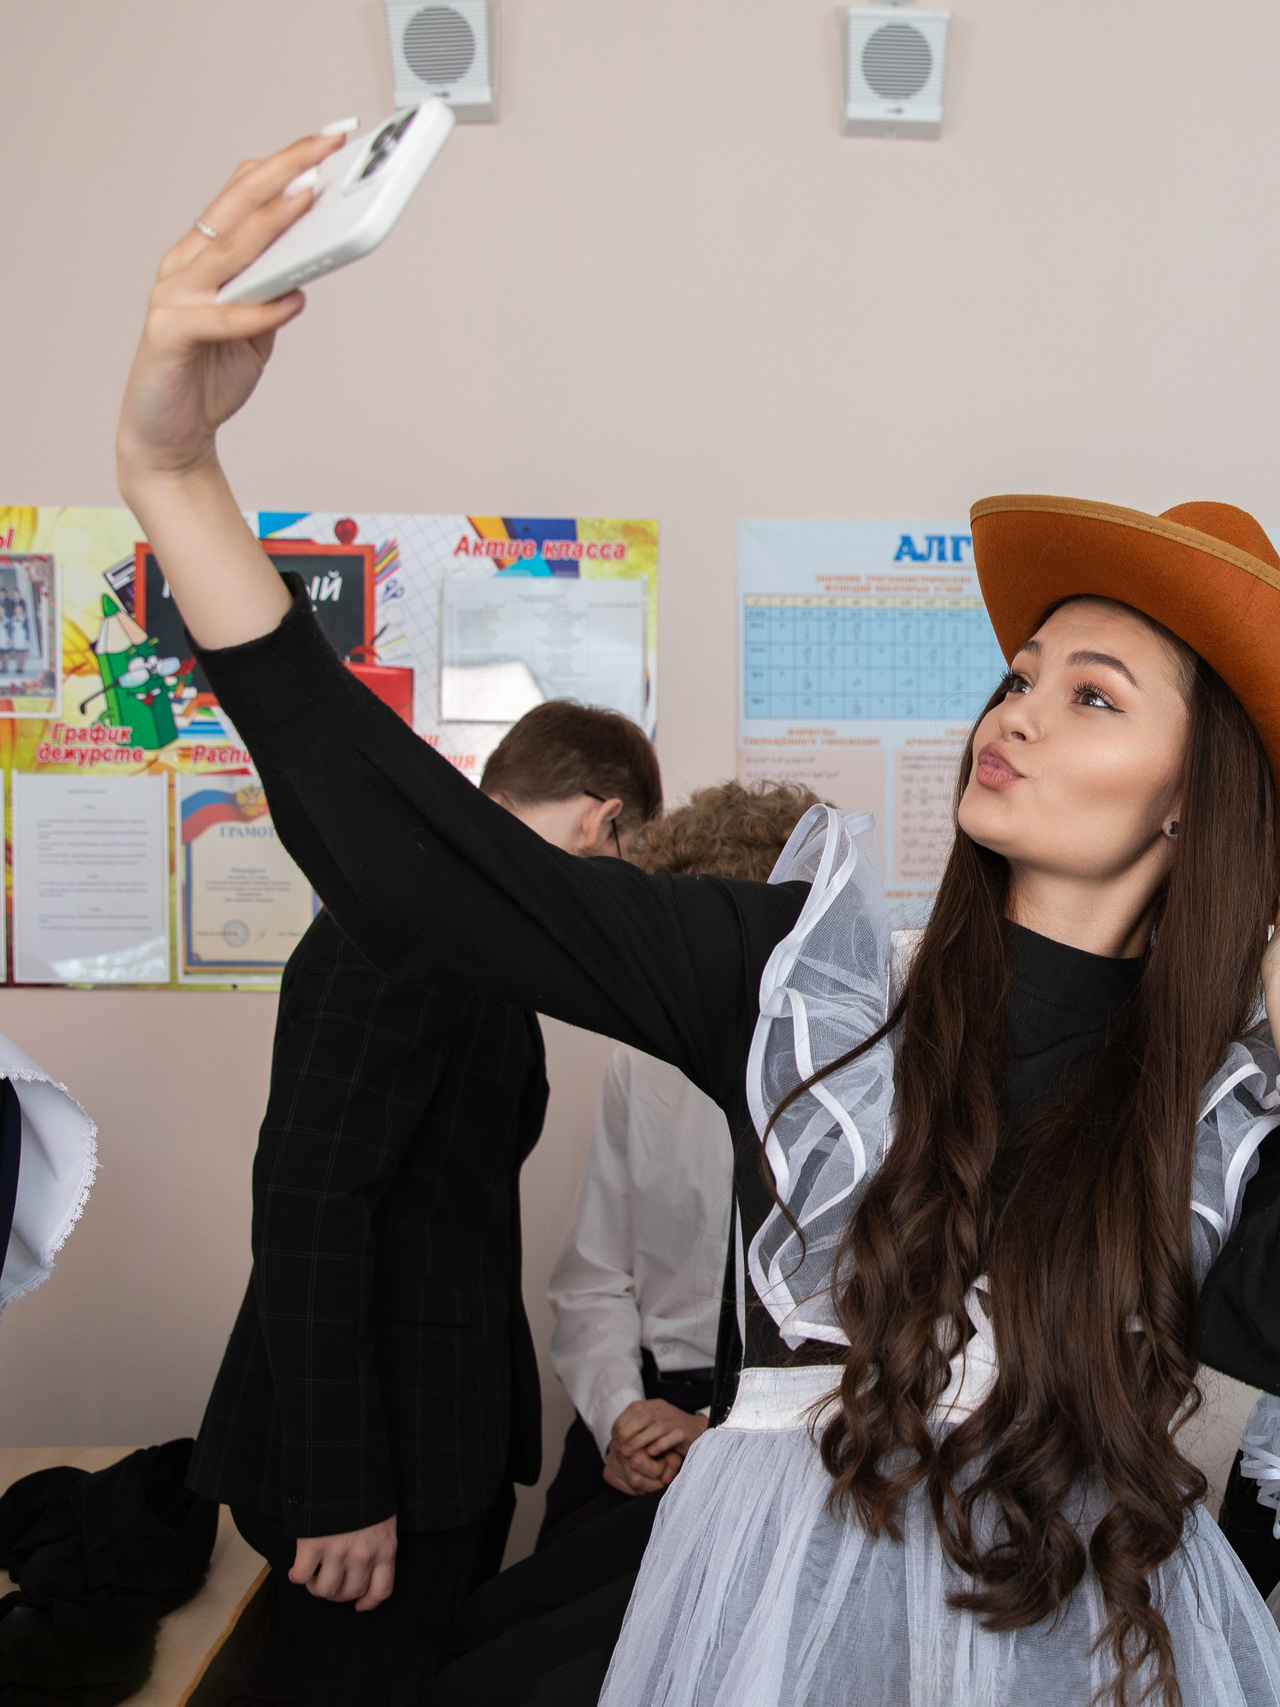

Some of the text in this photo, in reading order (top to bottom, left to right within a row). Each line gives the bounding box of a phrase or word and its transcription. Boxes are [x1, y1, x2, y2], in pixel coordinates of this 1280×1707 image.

[453, 535, 627, 559] Актив класса
[894, 535, 972, 562] АЛГ
[51, 723, 132, 745] График
[36, 742, 145, 765] дежурств
[192, 745, 251, 763] Распи
[219, 826, 276, 838] ГРАМОТ
